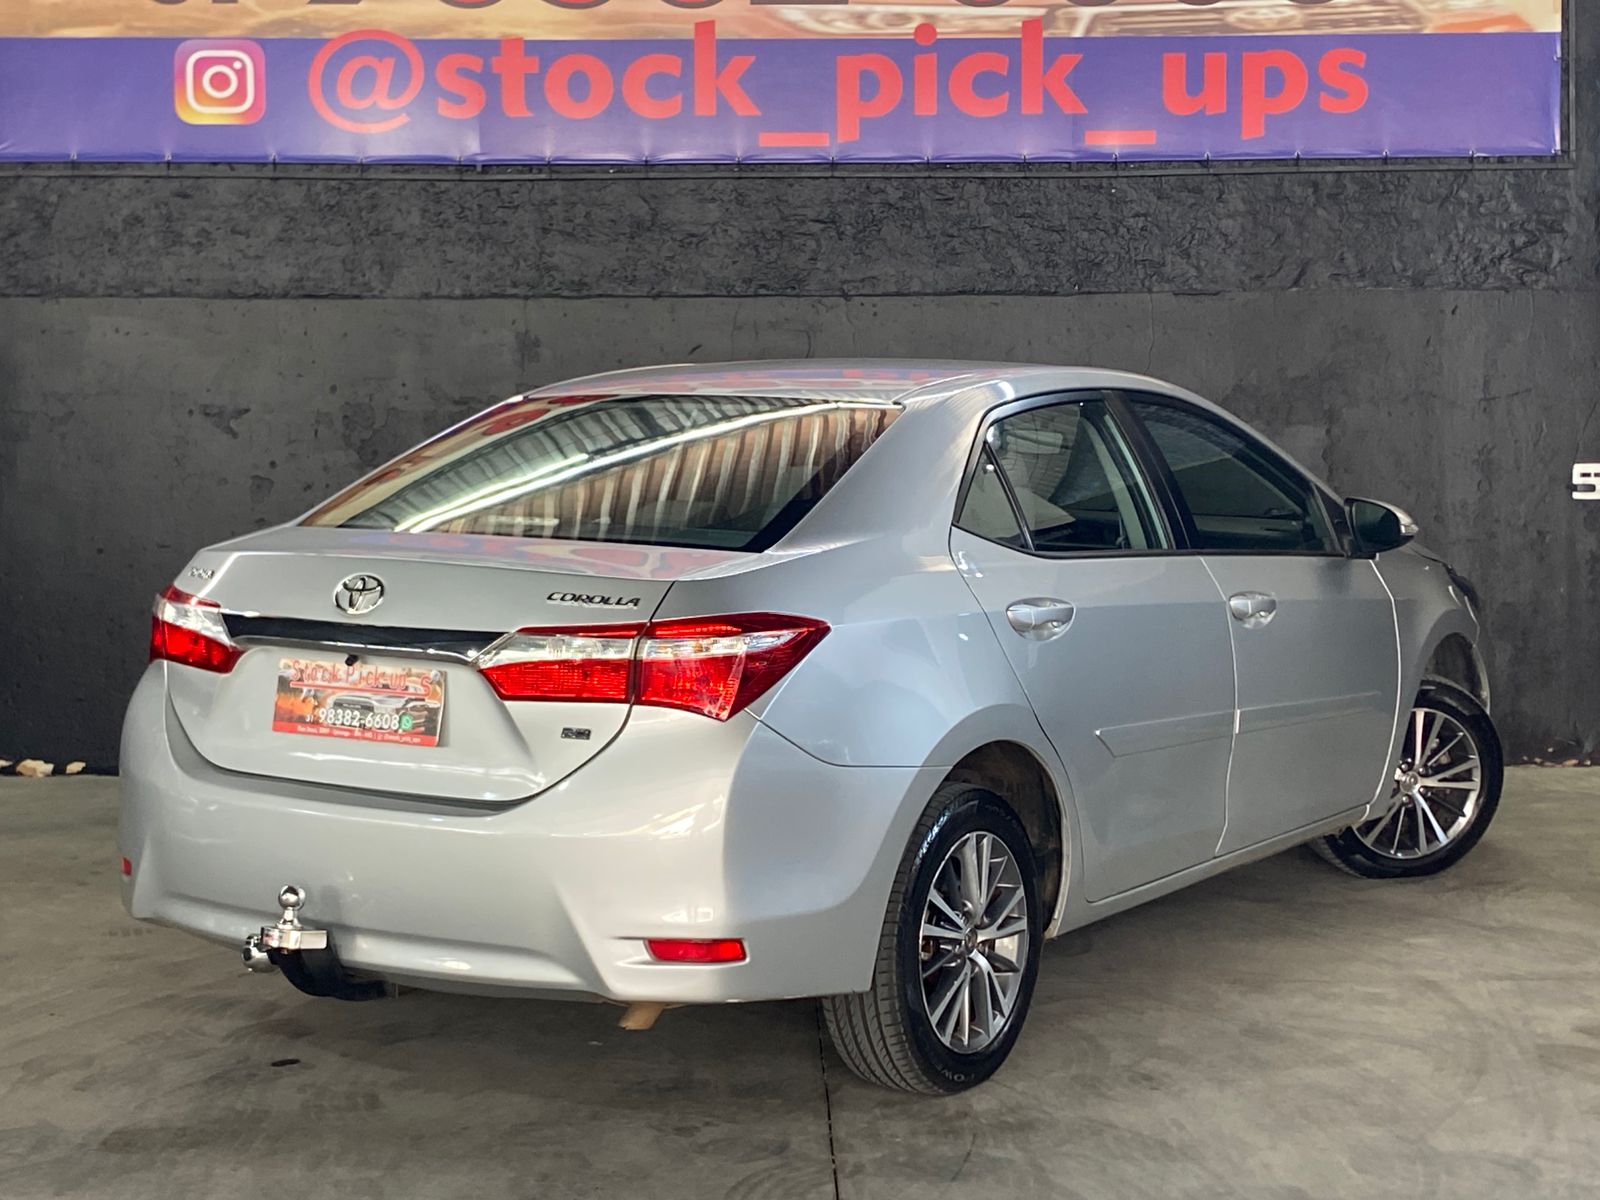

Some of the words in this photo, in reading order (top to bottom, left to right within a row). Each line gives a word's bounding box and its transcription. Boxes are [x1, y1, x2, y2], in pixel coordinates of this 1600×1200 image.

[308, 19, 1369, 147] @stock_pick_ups
[546, 591, 641, 607] COROLLA
[319, 707, 400, 731] 98382-6608
